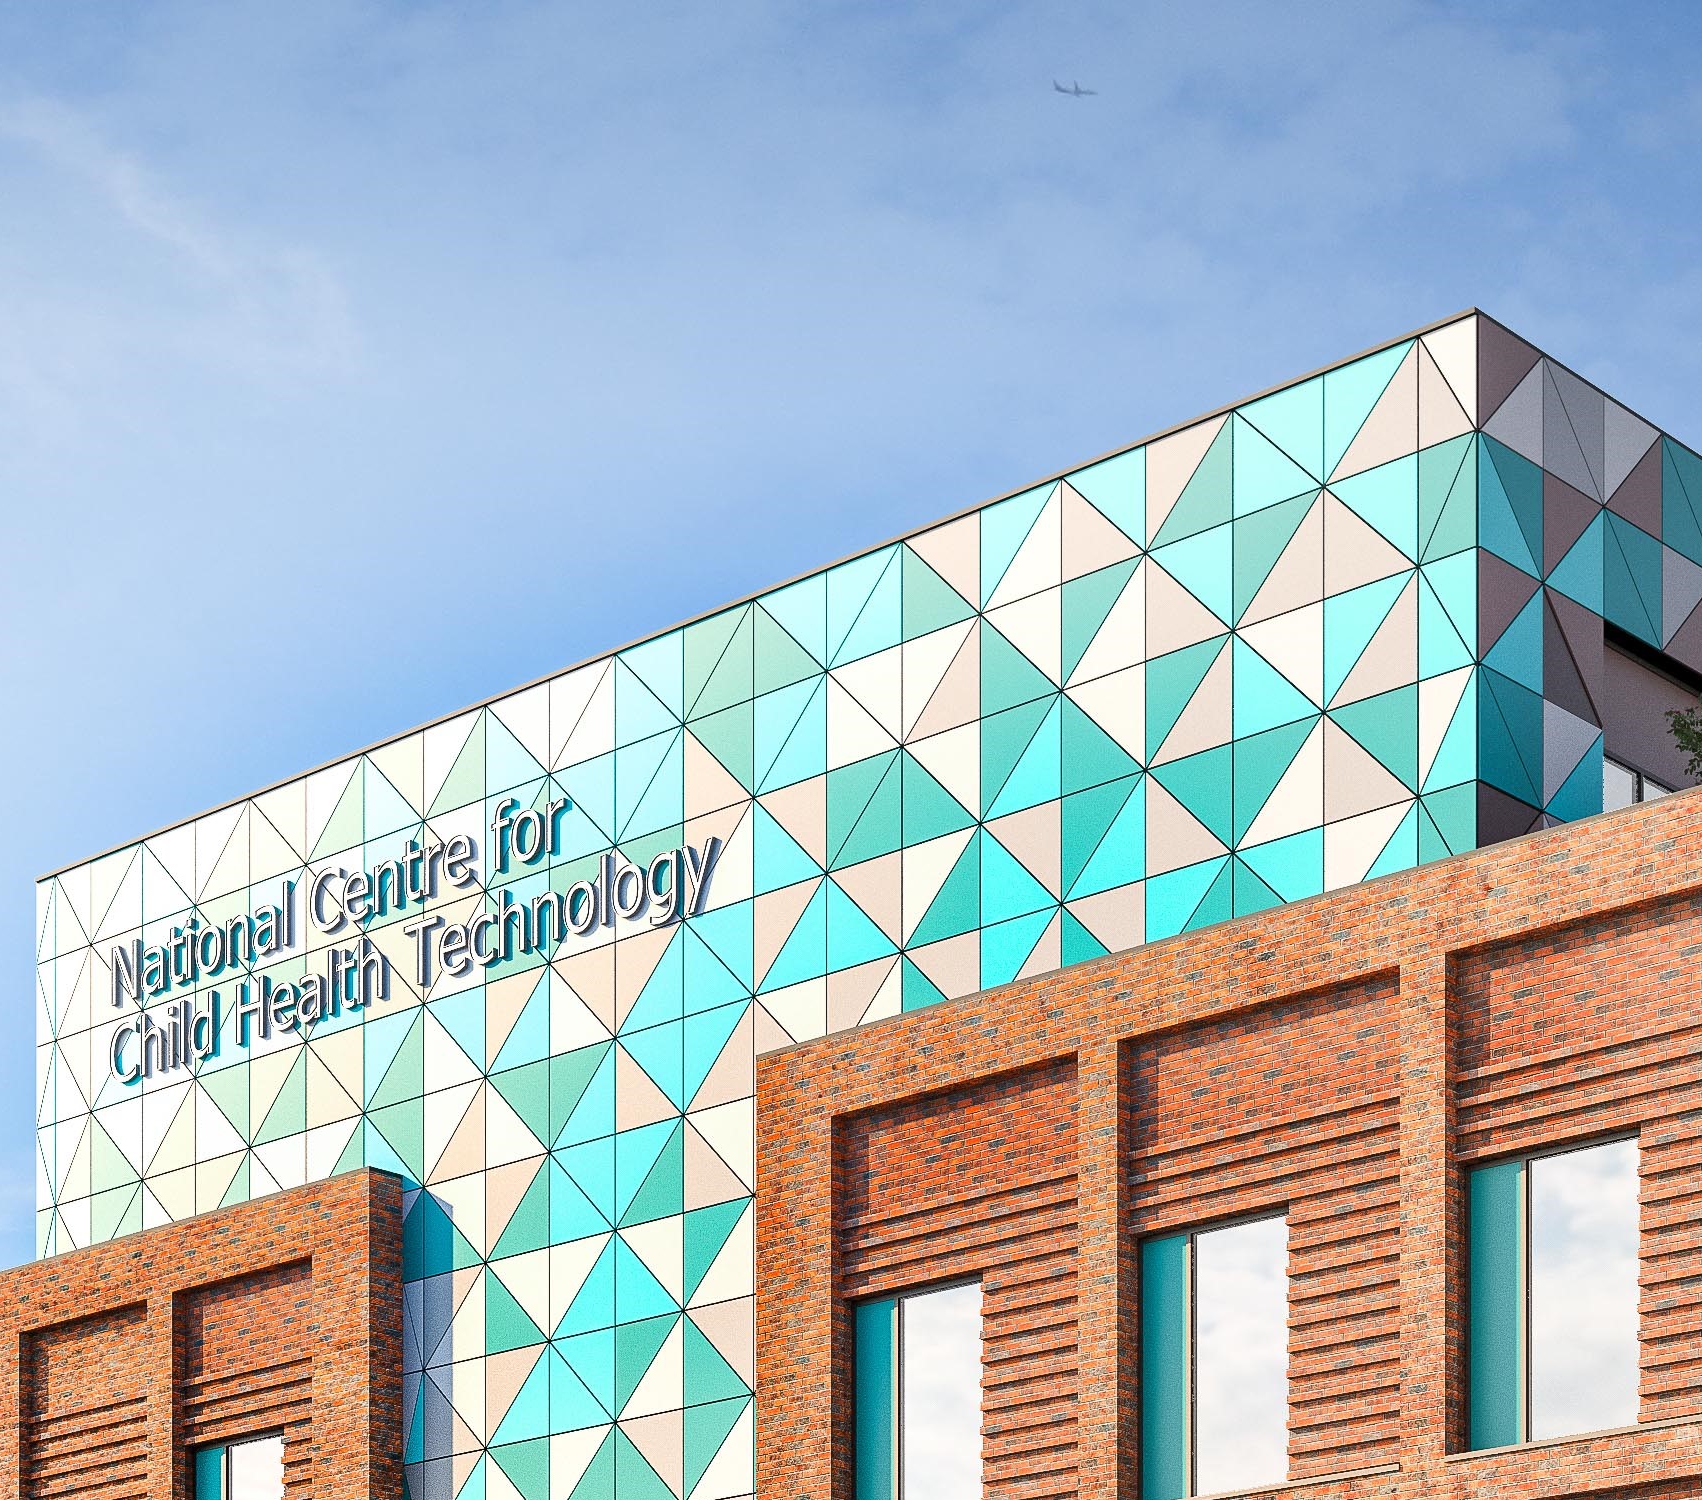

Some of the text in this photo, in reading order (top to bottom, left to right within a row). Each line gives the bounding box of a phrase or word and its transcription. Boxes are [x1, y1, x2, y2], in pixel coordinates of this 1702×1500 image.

[109, 797, 569, 1007] National Centre for
[109, 836, 723, 1086] Child Health Technology
